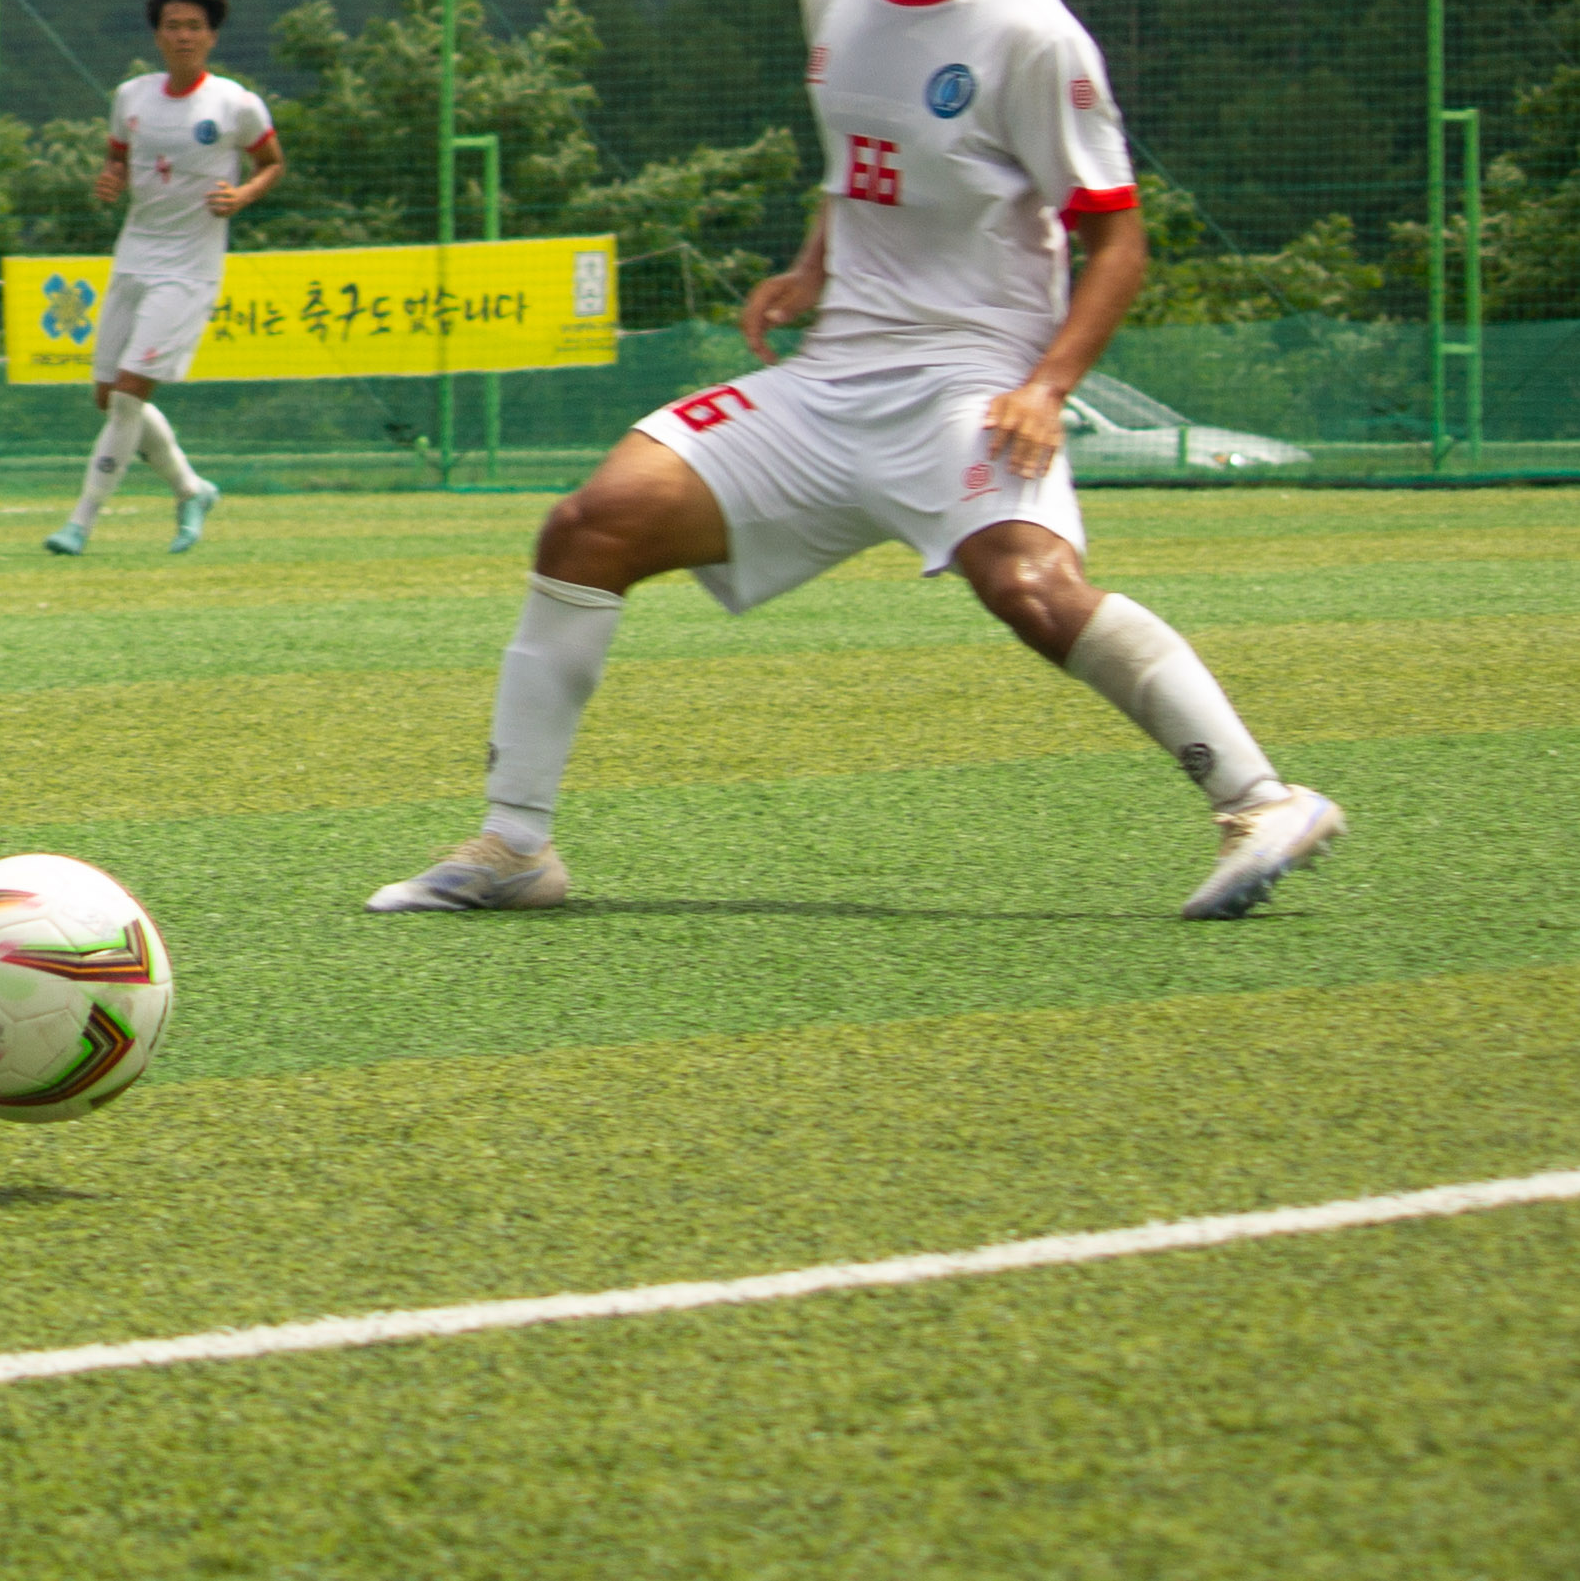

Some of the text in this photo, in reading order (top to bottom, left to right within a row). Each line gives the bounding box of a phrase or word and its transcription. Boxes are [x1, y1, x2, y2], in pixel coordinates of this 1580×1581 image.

[847, 133, 902, 206] 66
[300, 280, 392, 342] 축구도
[402, 282, 531, 338] 없습니다
